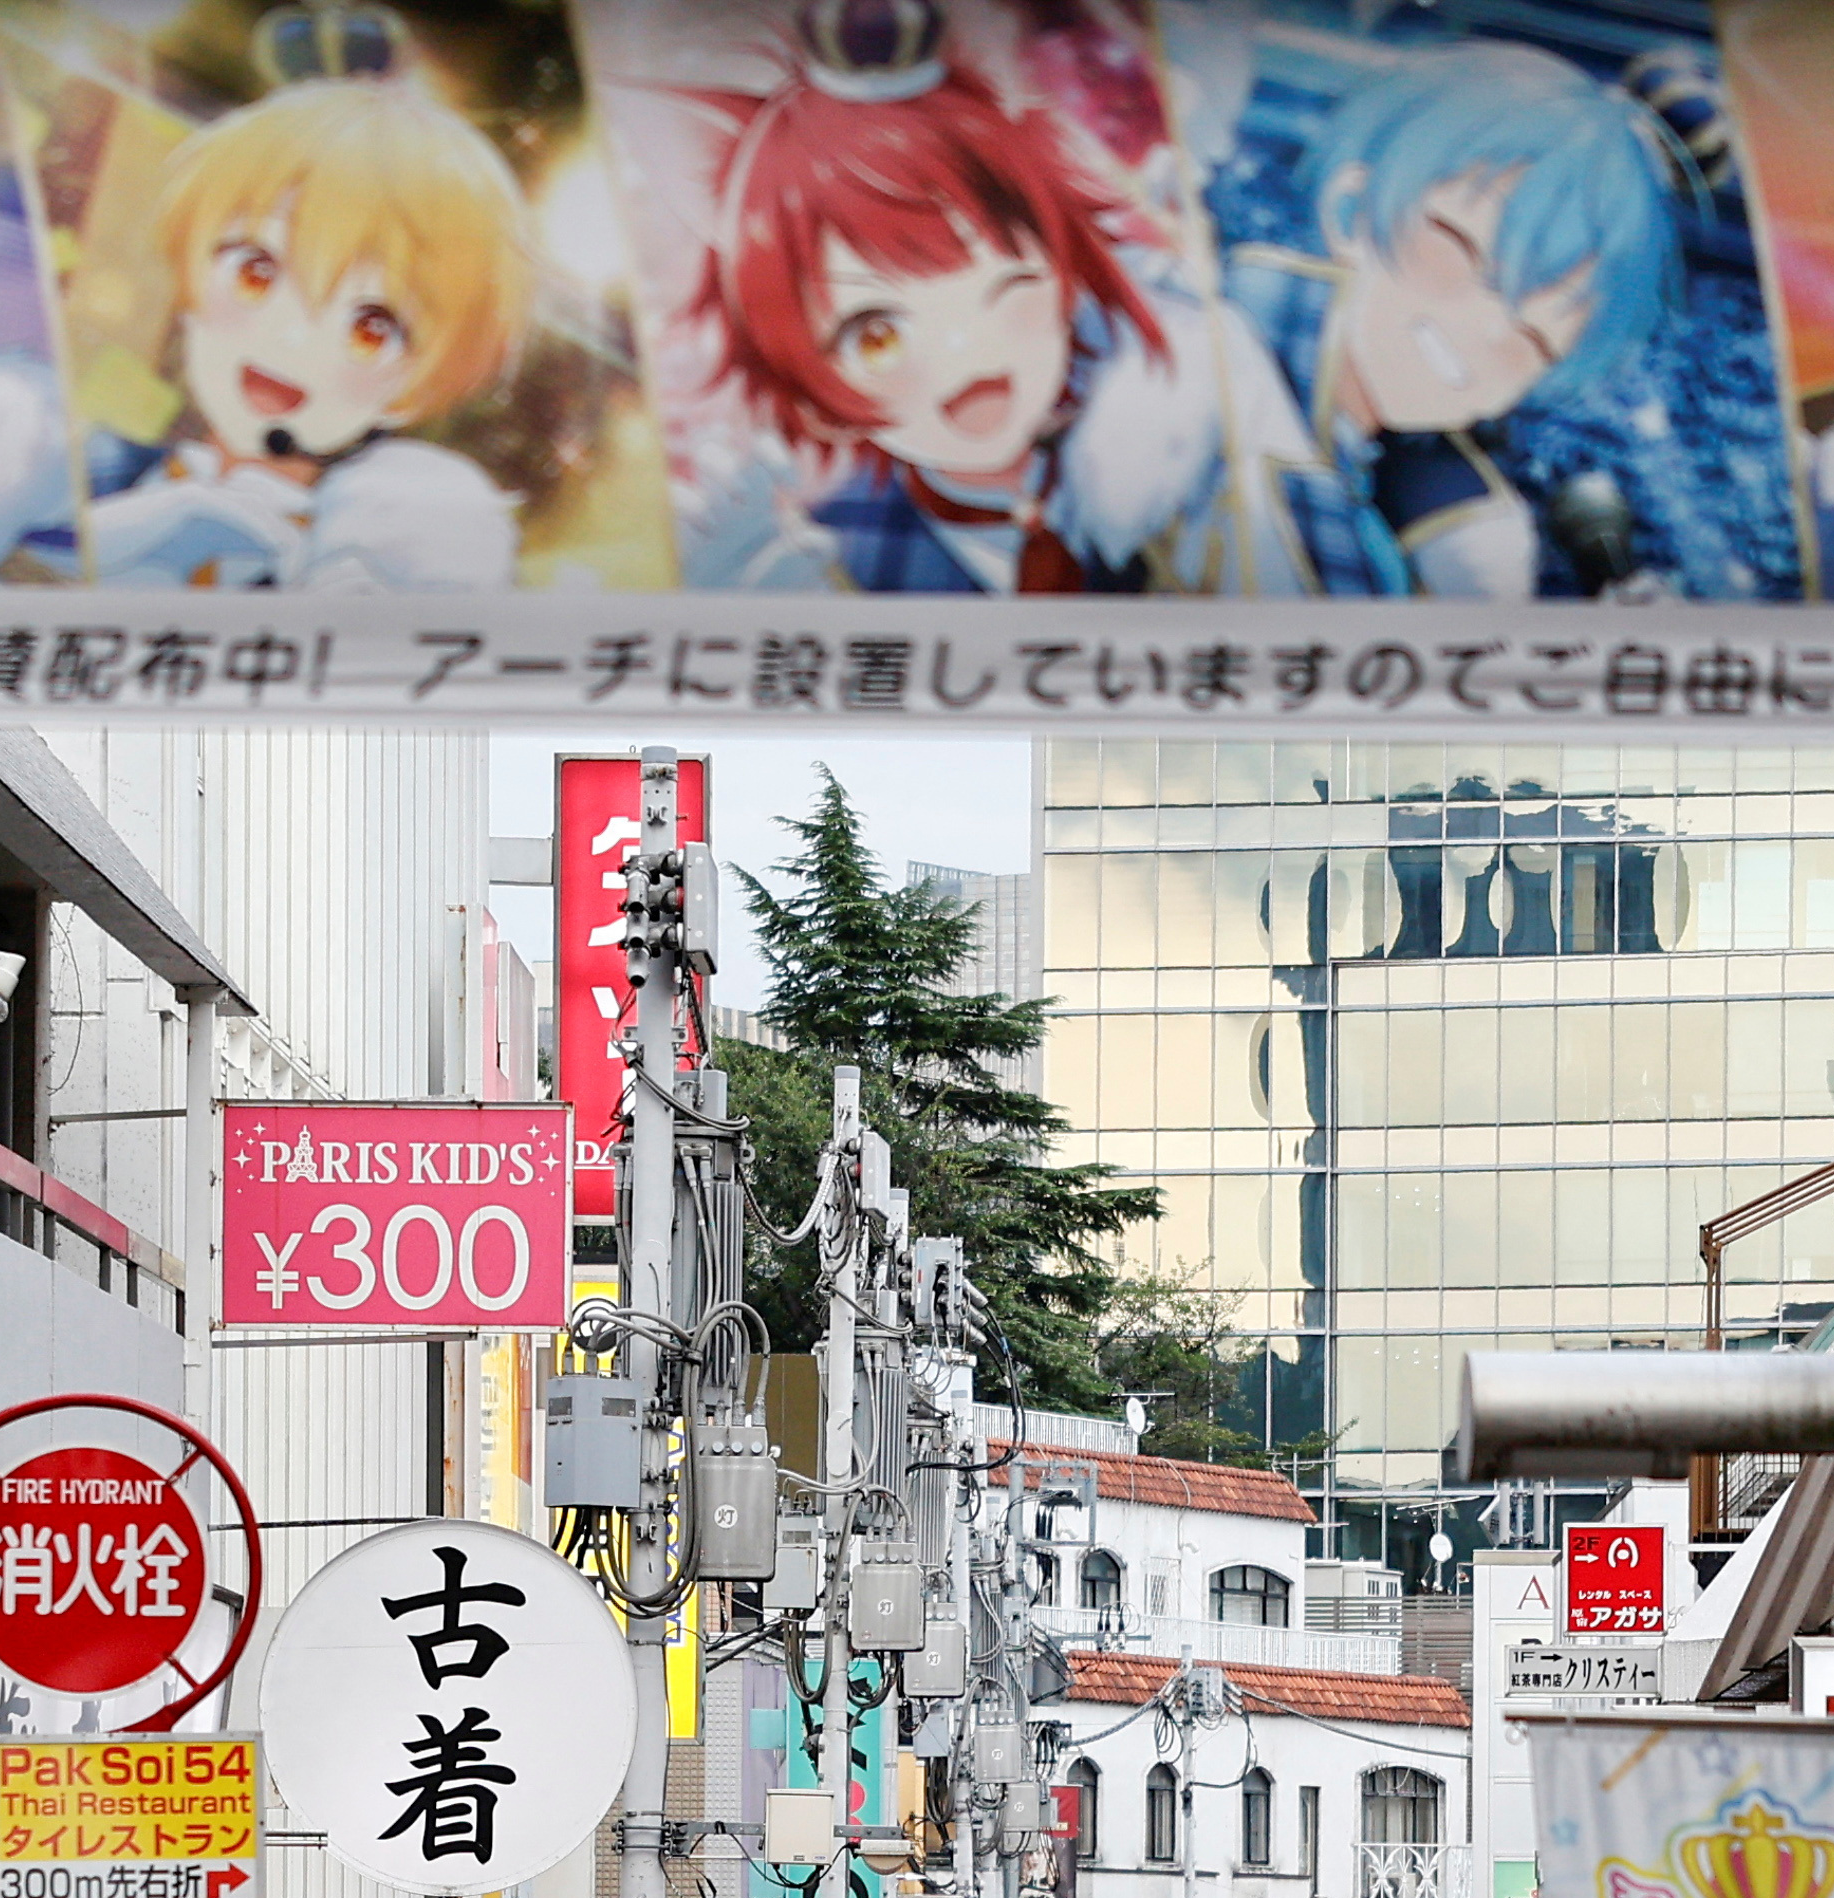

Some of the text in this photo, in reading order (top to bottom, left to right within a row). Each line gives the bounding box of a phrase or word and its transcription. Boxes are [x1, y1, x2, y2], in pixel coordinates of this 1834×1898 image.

[260, 1124, 400, 1185] PARIS
[410, 1140, 535, 1187] KID'S
[253, 1204, 531, 1312] ¥300
[1, 1479, 166, 1505] FIRE HYDRANT
[1572, 1536, 1601, 1551] 2F
[1517, 1574, 1552, 1610] A
[1578, 1588, 1653, 1601] レンタル スペース
[1588, 1605, 1663, 1630] アガサ
[1513, 1651, 1535, 1664] 1F
[1563, 1657, 1657, 1691] クリスティー
[377, 1545, 527, 1867] 古着
[1, 1746, 251, 1787] Pak Soi 54
[1, 1791, 252, 1816] Thai Restaurant
[2, 1825, 251, 1858] タイレストラン
